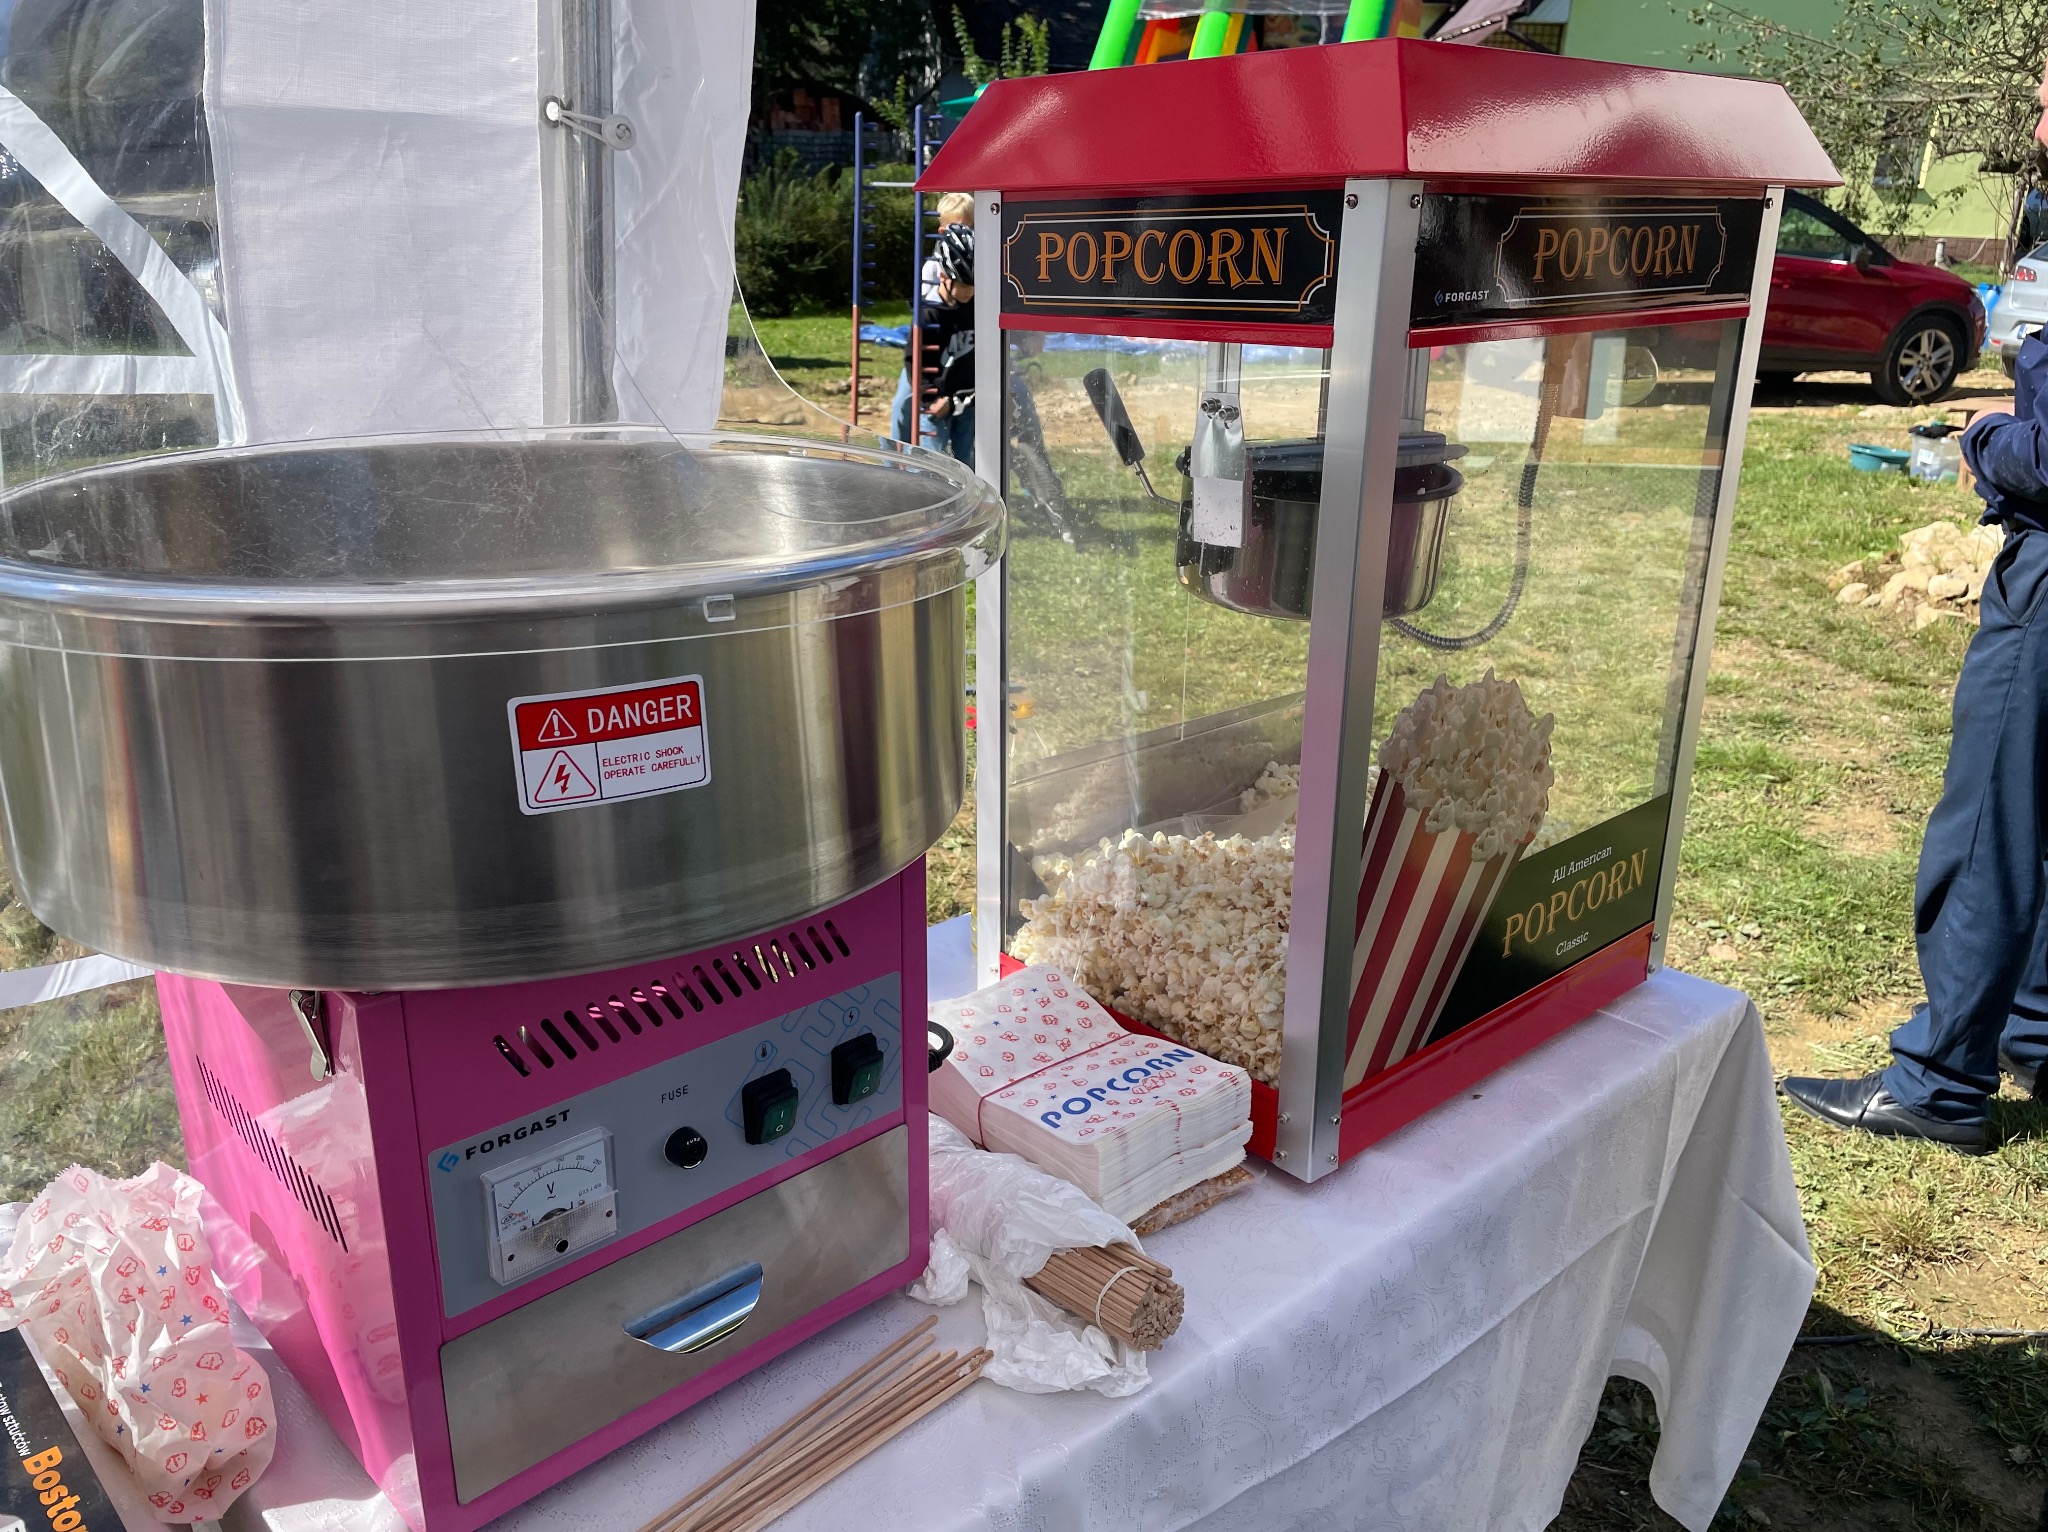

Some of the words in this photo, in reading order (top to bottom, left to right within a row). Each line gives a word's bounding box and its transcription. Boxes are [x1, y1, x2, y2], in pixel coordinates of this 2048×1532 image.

[1035, 226, 1290, 287] POPCORN
[1532, 224, 1702, 283] POPCORN
[1444, 289, 1491, 303] FORGAST
[587, 694, 693, 734] DANGER
[602, 751, 651, 767] ELECTRIC
[655, 745, 684, 758] SHOCK
[603, 765, 646, 780] OPERATE
[651, 754, 702, 772] CAREFULLY
[1551, 865, 1566, 884] All
[1567, 846, 1612, 876] American
[1501, 848, 1649, 960] POPCORN
[1555, 930, 1590, 957] Classic
[661, 1084, 689, 1104] FUSE
[1040, 1048, 1195, 1129] POPCORN
[465, 1108, 571, 1160] FORGAST
[2, 1415, 31, 1457] sztućców
